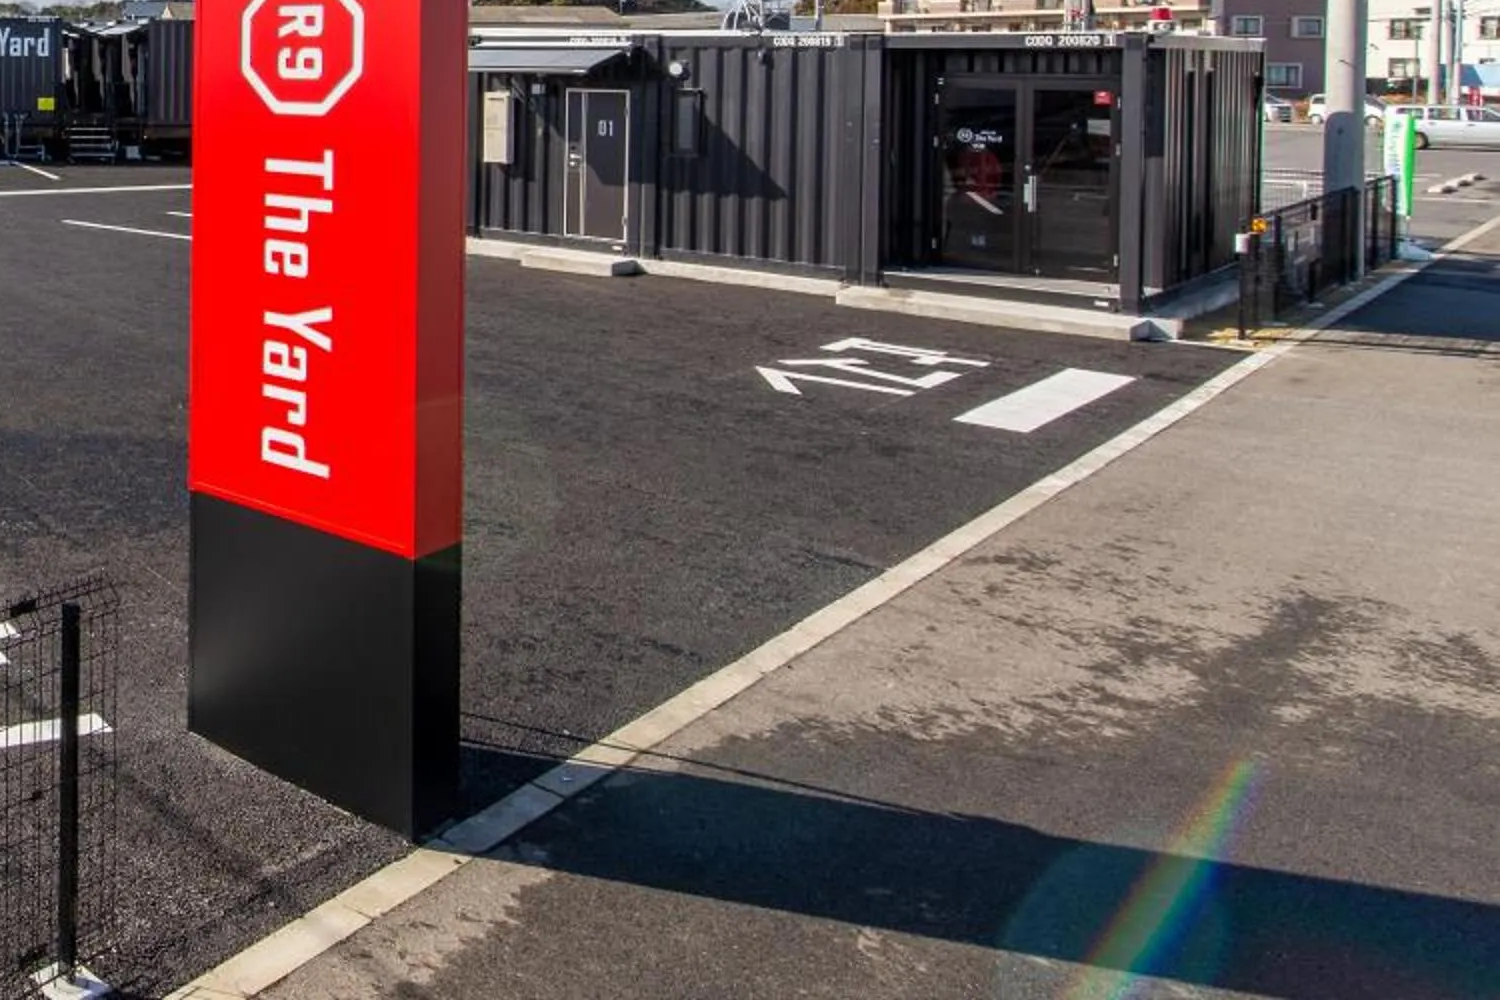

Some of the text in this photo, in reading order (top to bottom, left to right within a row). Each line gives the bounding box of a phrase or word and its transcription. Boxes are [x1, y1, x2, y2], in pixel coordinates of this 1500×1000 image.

[276, 3, 325, 82] R9
[260, 149, 334, 480] The Yard
